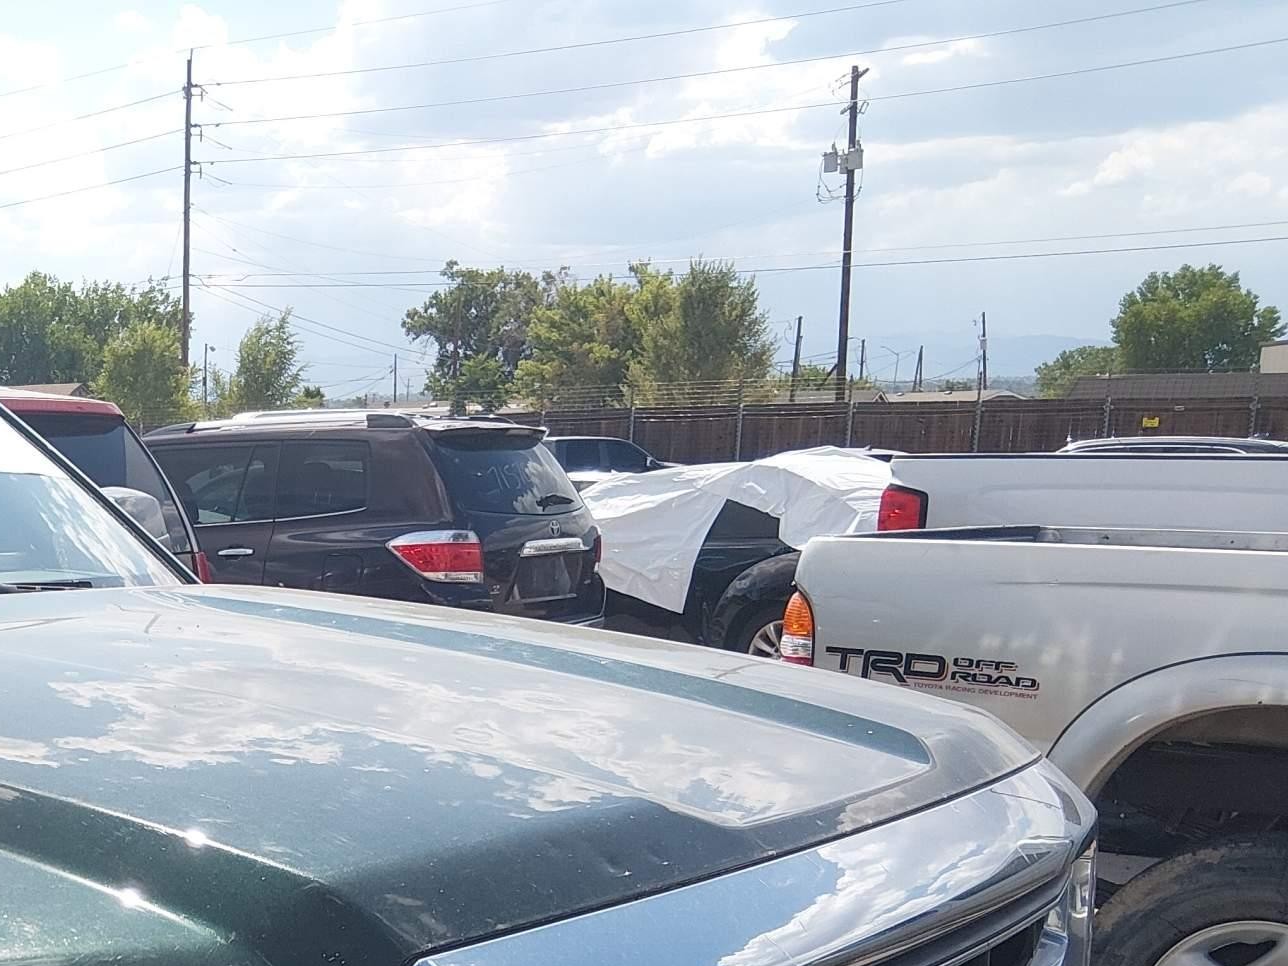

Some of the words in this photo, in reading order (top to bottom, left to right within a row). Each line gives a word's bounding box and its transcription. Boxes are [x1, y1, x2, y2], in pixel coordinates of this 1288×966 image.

[825, 646, 948, 687] TRD
[953, 656, 1018, 672] OFF
[950, 670, 1040, 691] ROAD
[912, 682, 943, 691] TOYOTA
[945, 685, 976, 694] RACING
[978, 688, 1039, 700] DEVELOPMENT
